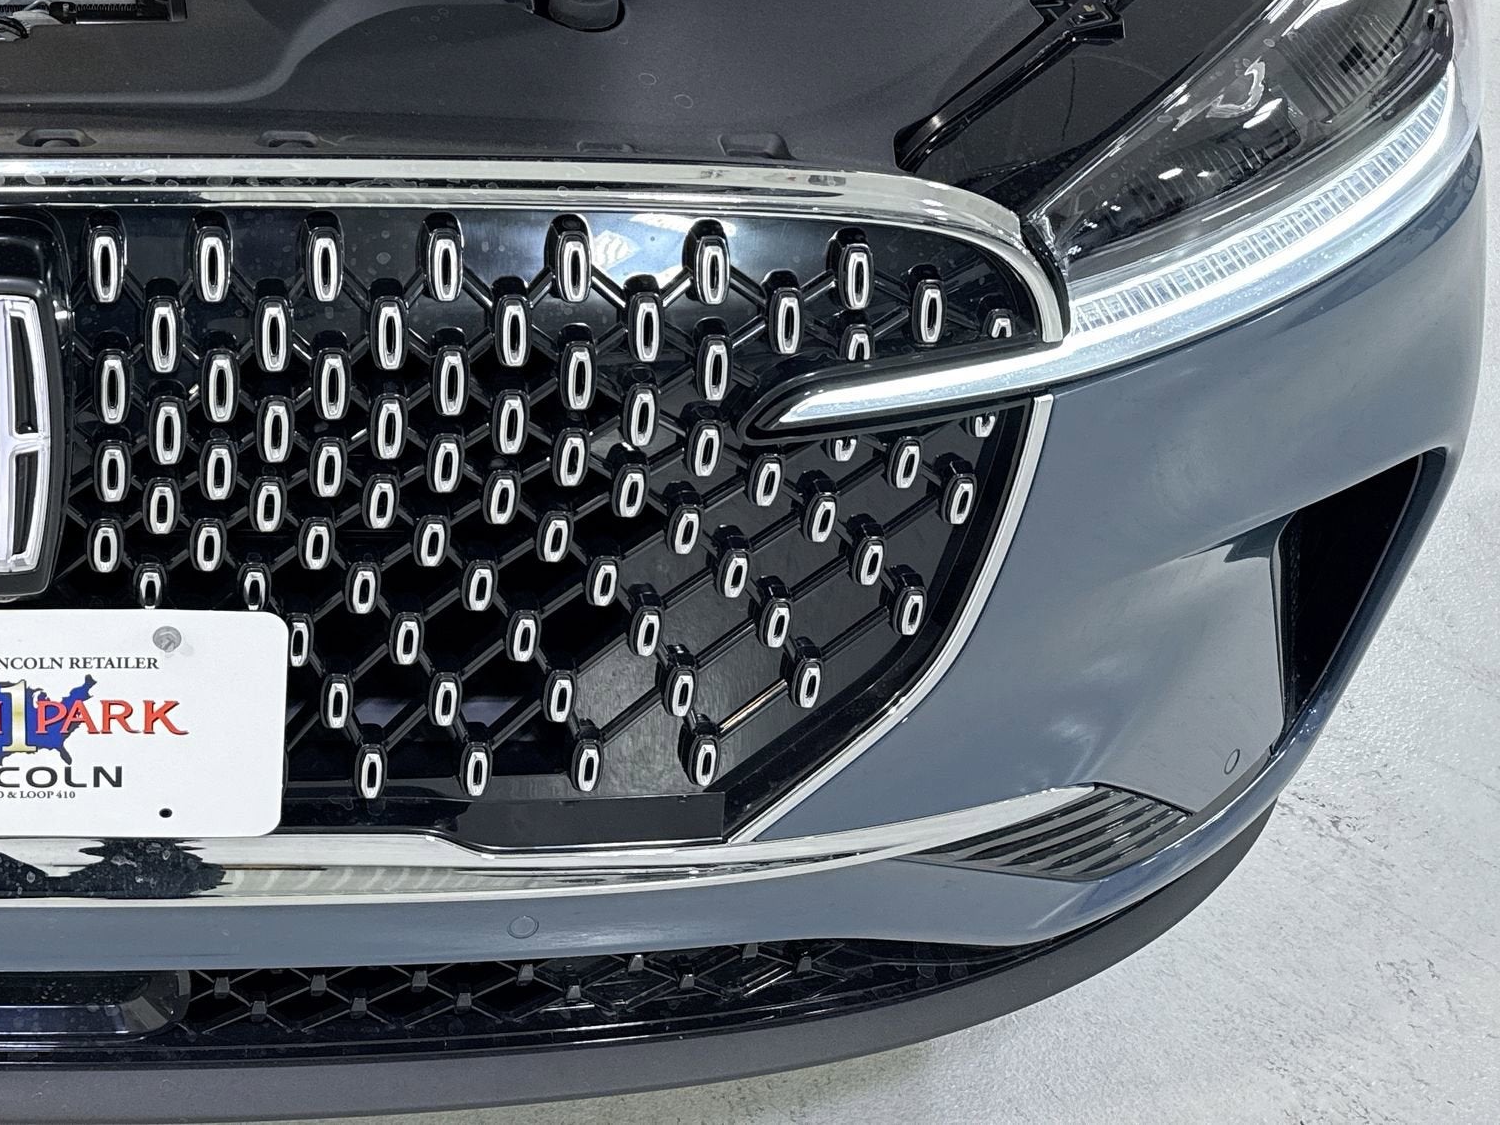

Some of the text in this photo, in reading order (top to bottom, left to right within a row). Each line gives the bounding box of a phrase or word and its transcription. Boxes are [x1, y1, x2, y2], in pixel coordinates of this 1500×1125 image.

[69, 656, 160, 670] RETAILER
[35, 700, 190, 736] PARK
[7, 790, 17, 799] &
[20, 790, 54, 799] LOOP
[56, 790, 76, 799] 410
